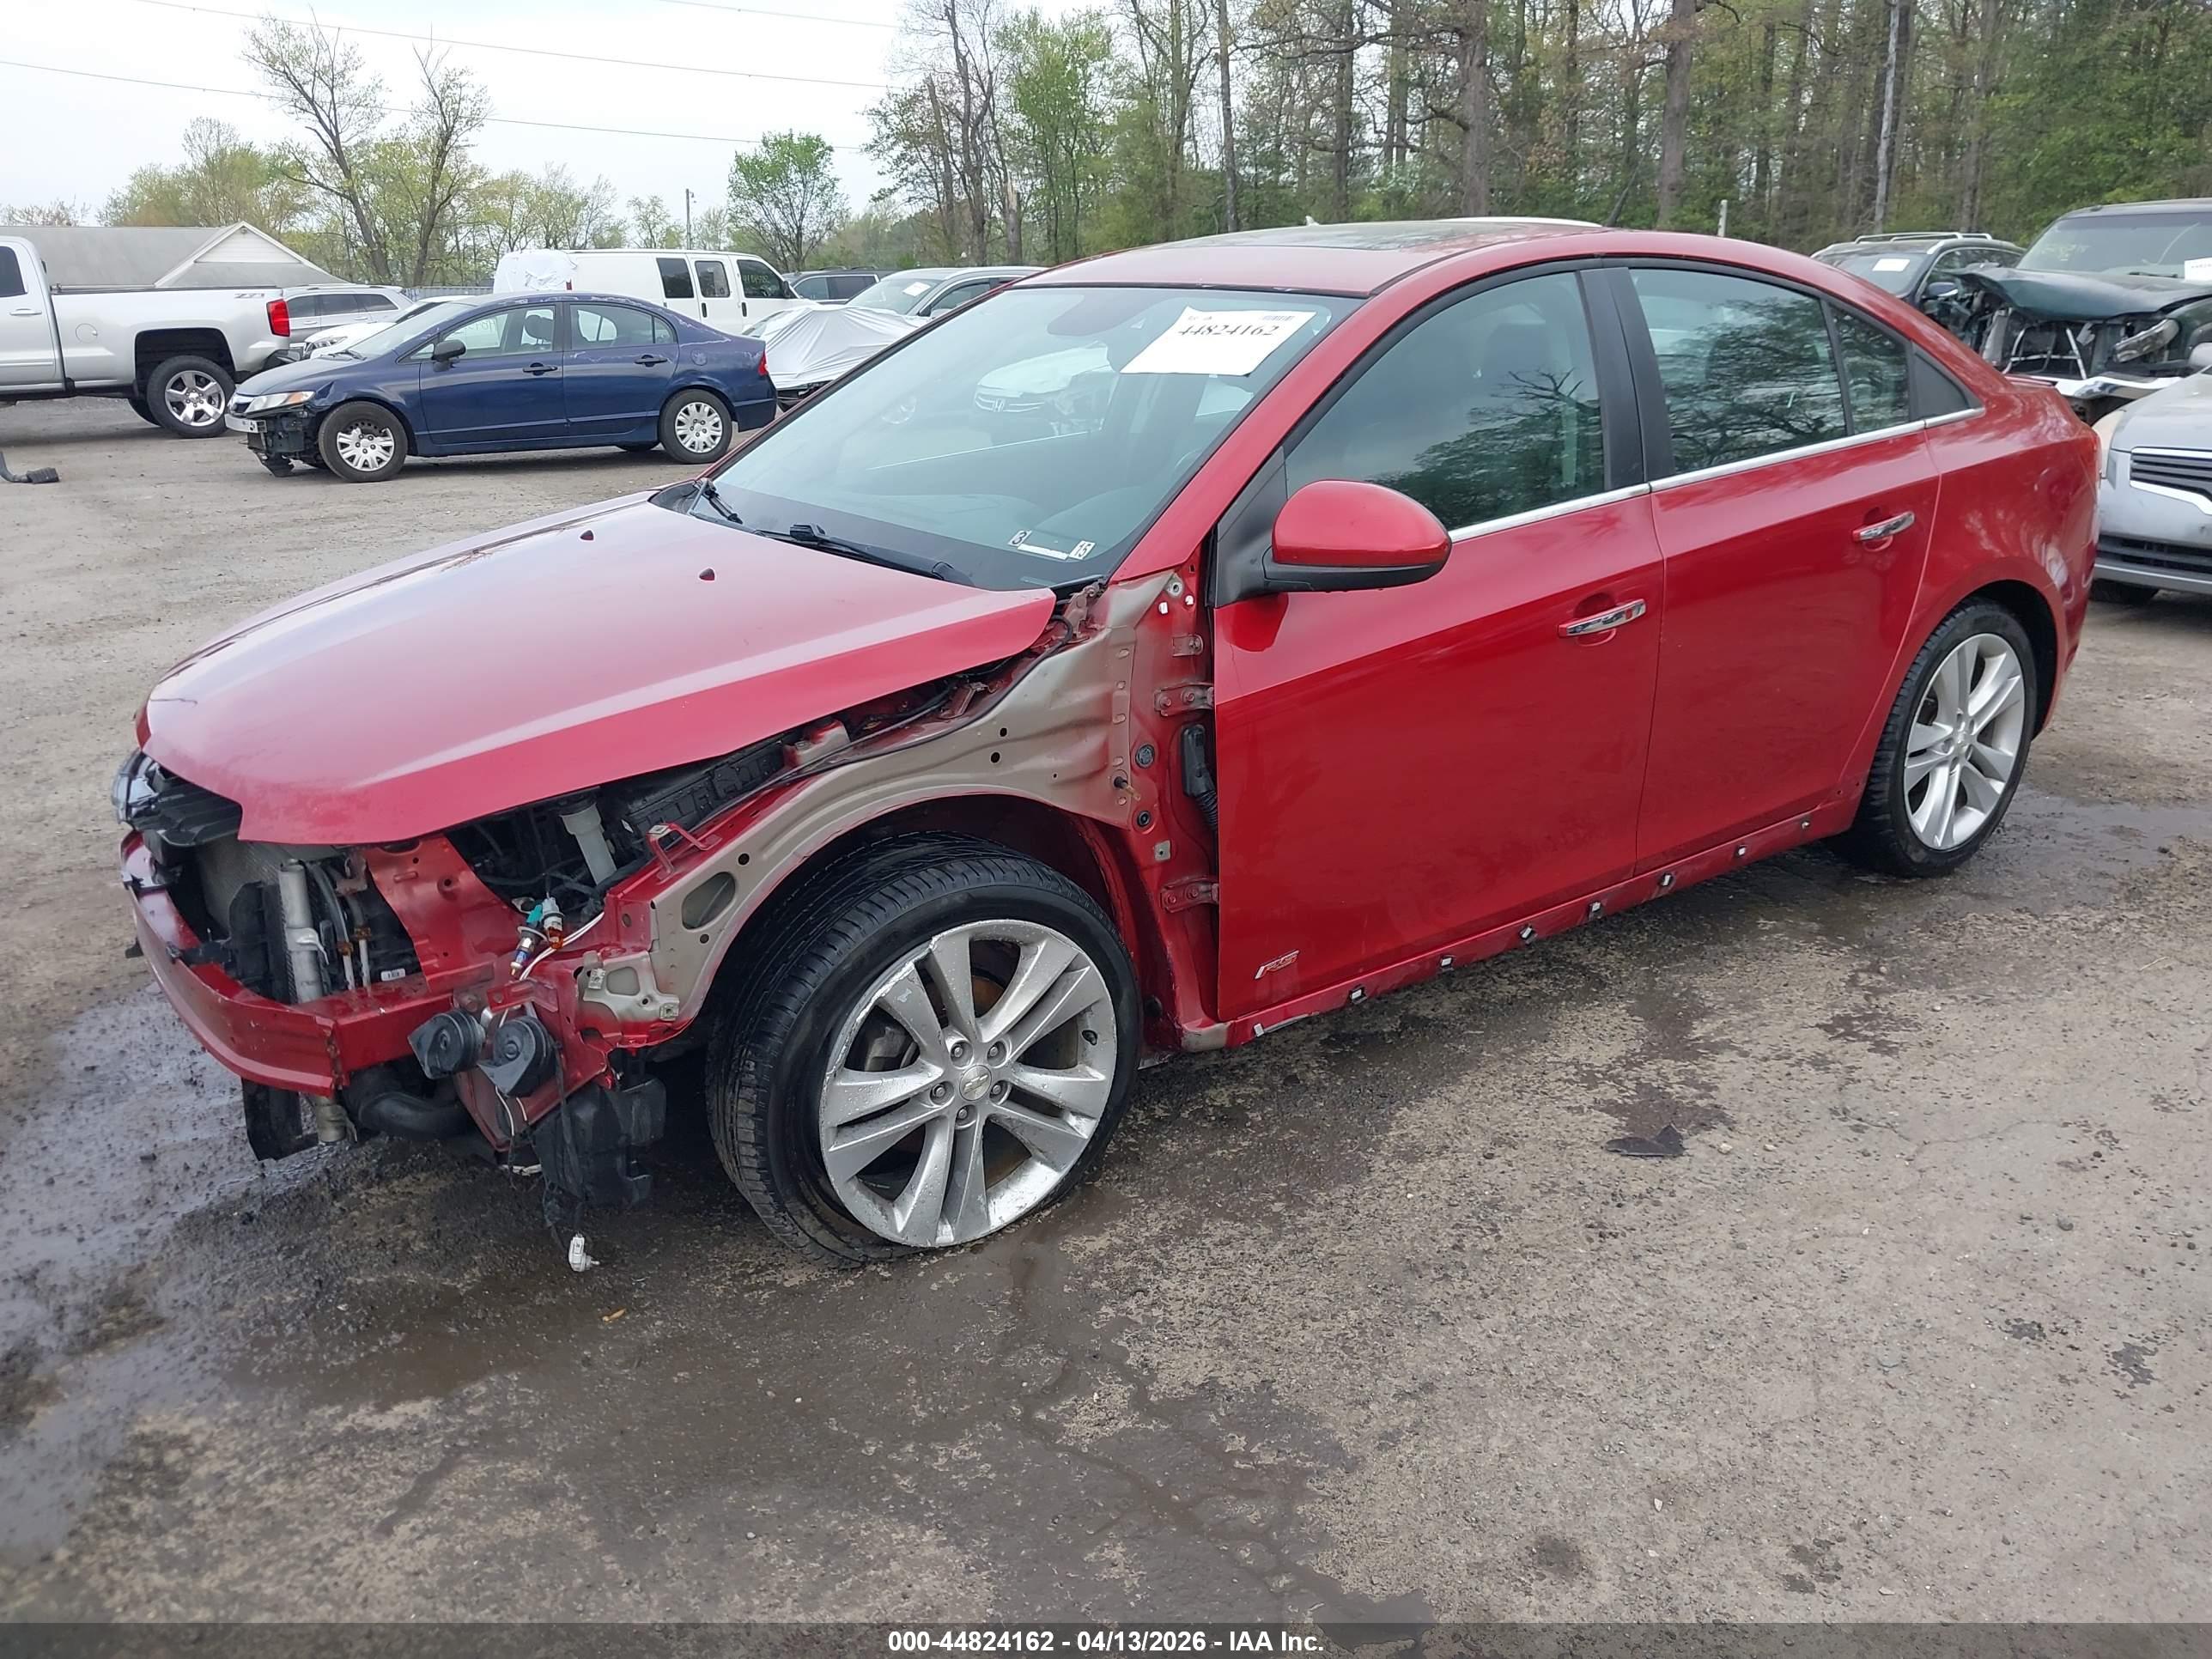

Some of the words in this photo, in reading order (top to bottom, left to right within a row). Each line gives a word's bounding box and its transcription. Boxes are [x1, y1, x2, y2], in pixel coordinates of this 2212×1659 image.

[1178, 325, 1280, 336] 44824162
[1012, 532, 1027, 545] 3
[1074, 542, 1091, 558] 15
